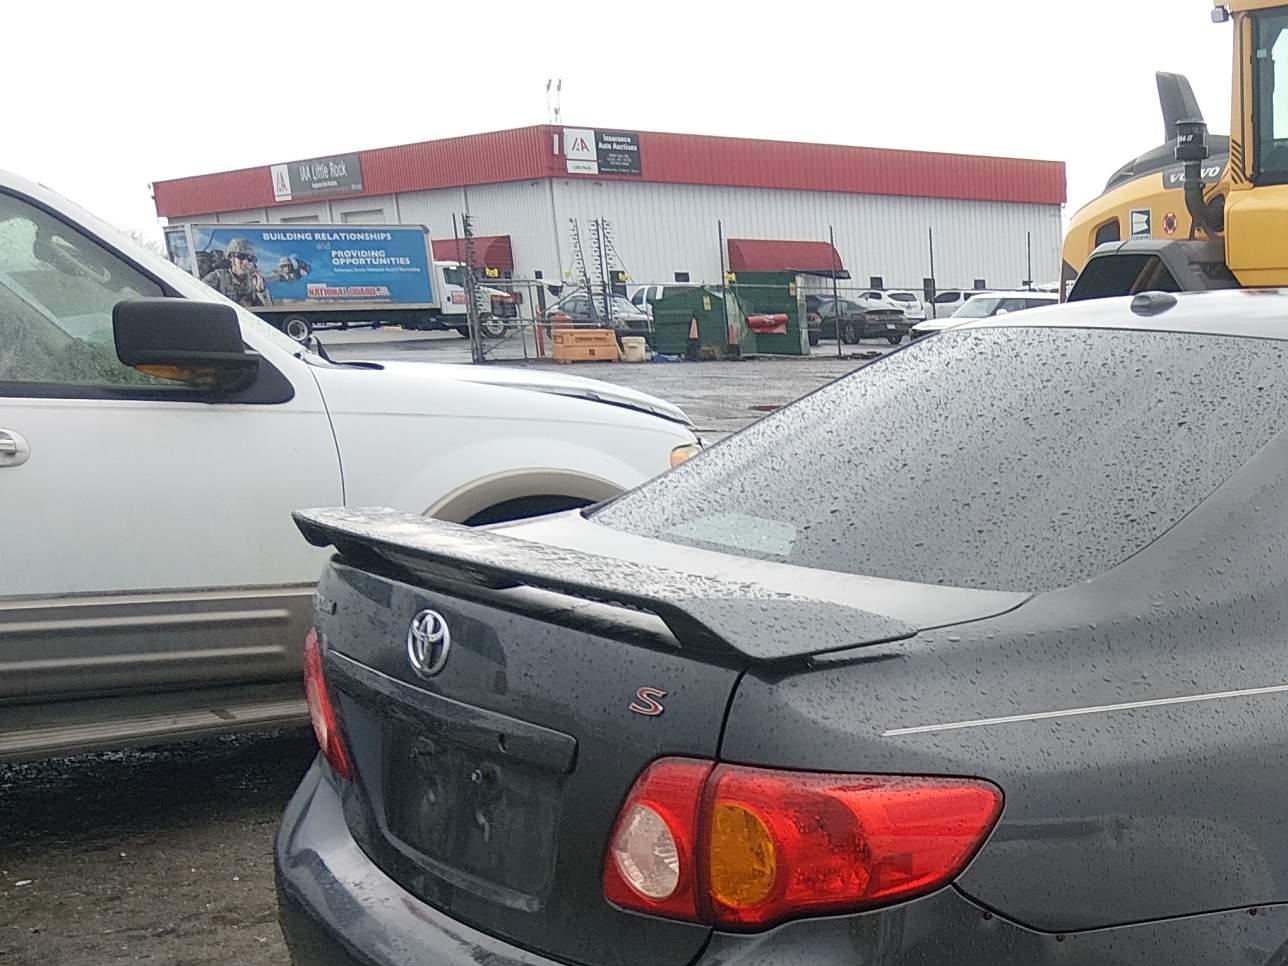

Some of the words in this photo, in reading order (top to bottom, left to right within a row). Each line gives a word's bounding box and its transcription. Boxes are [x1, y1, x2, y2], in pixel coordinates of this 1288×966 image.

[603, 133, 631, 142] Insurance
[598, 141, 612, 150] Auto
[612, 142, 638, 152] Auctions
[312, 163, 329, 180] Little
[330, 161, 348, 178] Rock
[262, 232, 312, 240] BUILDING
[314, 232, 392, 240] RELATIONSHIPS
[316, 242, 331, 250] and
[332, 257, 410, 265] OPPORTUNITIES
[308, 286, 349, 297] NATIONAL
[628, 686, 668, 716] S
